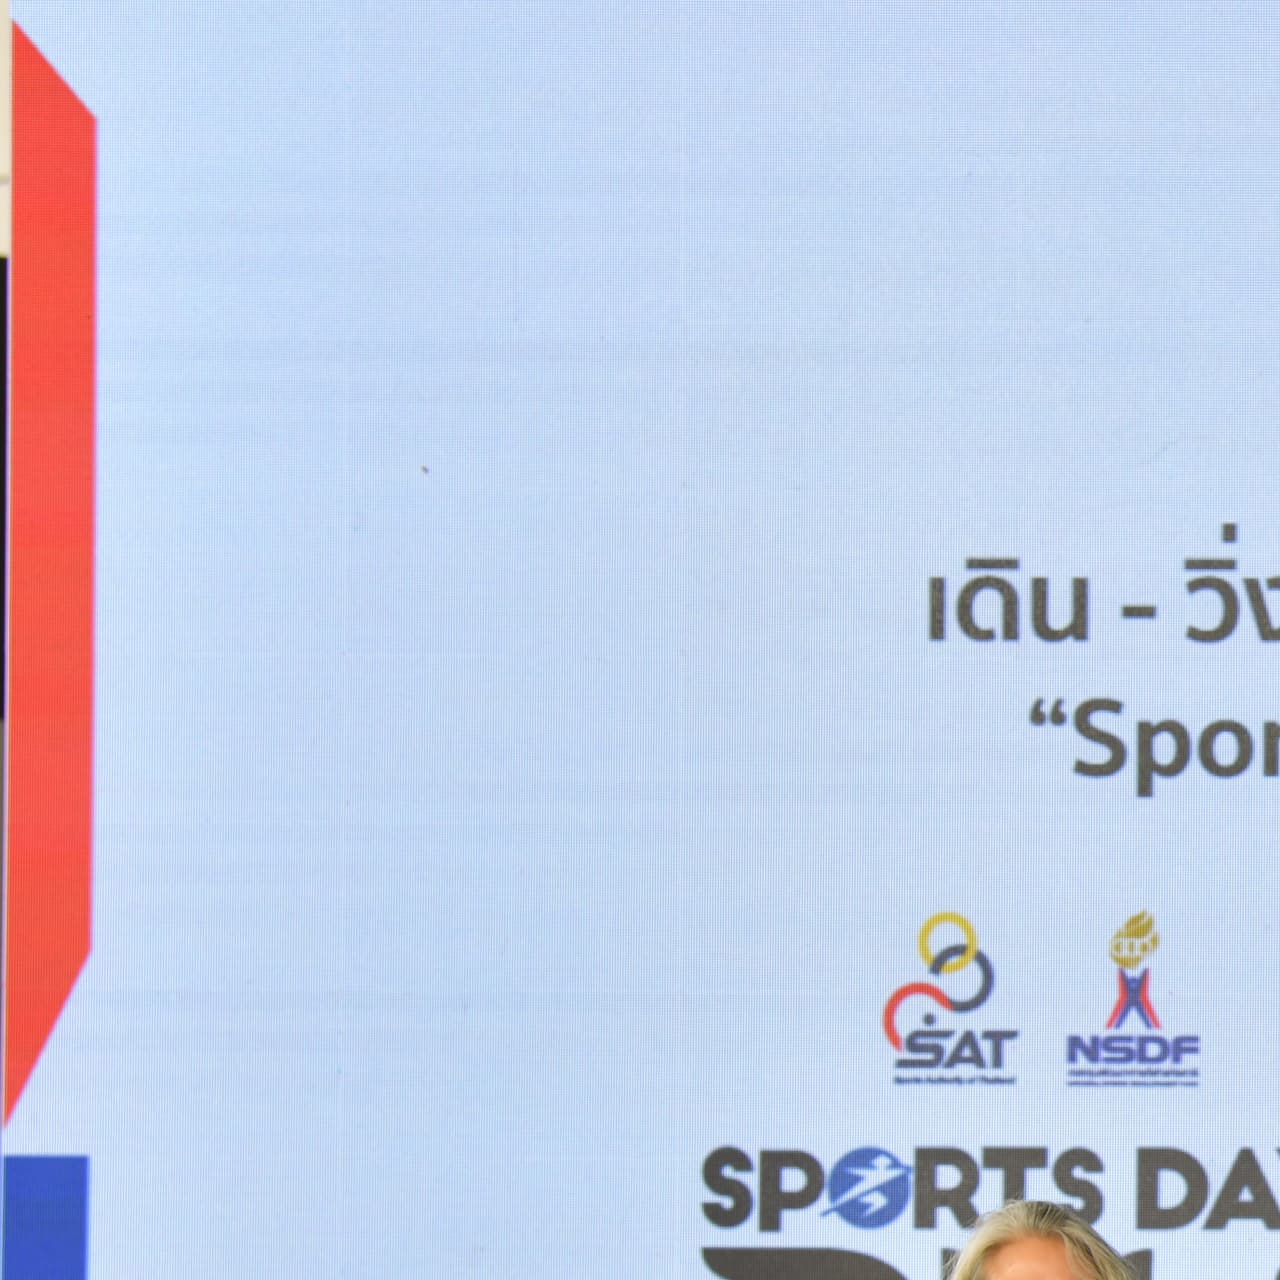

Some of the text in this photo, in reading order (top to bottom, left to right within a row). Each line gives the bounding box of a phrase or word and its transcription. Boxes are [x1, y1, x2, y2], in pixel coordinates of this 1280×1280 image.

[928, 558, 1090, 644] เดิน
[1121, 604, 1157, 620] -
[895, 1029, 1019, 1070] SAT
[1066, 1034, 1200, 1064] NSDF
[702, 1146, 1105, 1232] SPORTS
